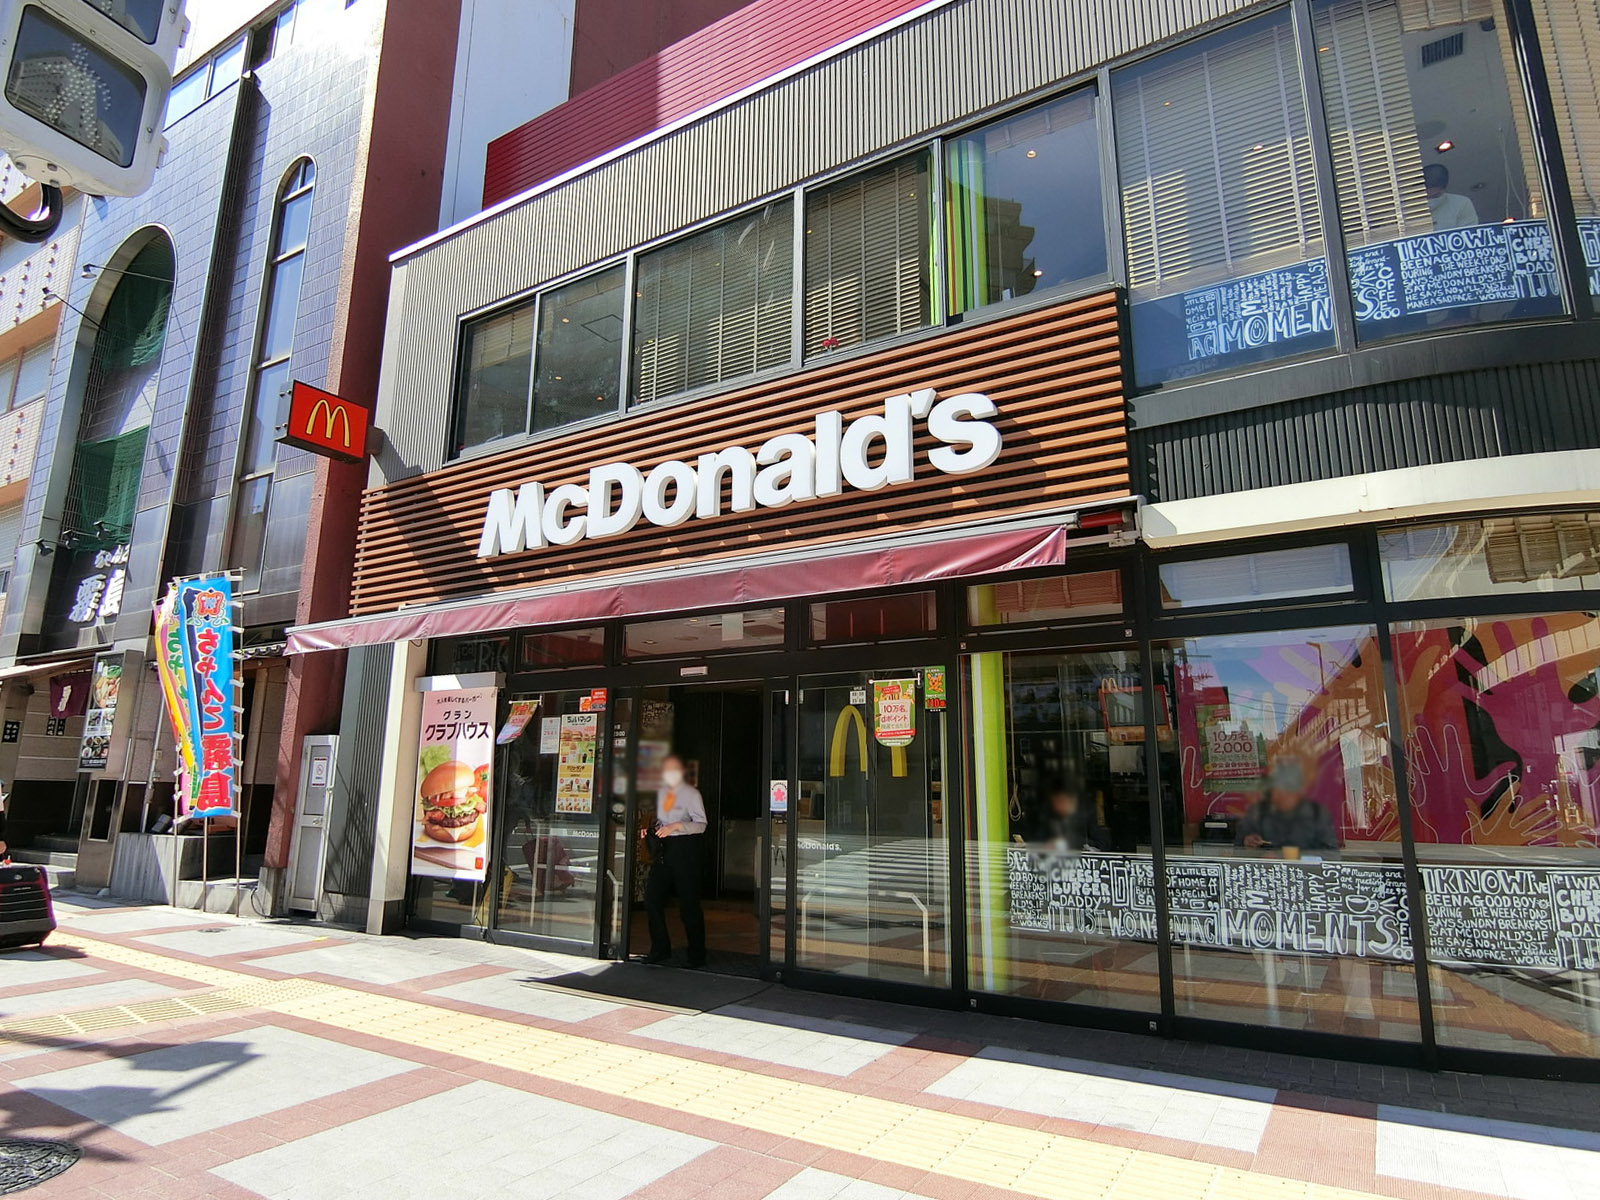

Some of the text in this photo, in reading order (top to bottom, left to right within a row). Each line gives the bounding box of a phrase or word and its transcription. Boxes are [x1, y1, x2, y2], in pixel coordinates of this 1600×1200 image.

[1524, 226, 1550, 237] WA
[1407, 229, 1487, 260] KNOW
[1512, 236, 1553, 252] CHEE
[1400, 256, 1433, 271] BEEN
[1433, 256, 1442, 265] A
[1441, 250, 1475, 264] GOOD
[1475, 248, 1496, 258] BOY
[1516, 248, 1556, 264] BUR
[1401, 265, 1434, 280] DURING
[1439, 261, 1457, 272] THE
[1456, 258, 1482, 269] WEEK
[1525, 261, 1556, 274] DAD
[1403, 262, 1510, 288] SAYS SUNDAY BREAKFAST
[1296, 272, 1313, 302] HAPPY
[1414, 284, 1426, 293] AT
[1405, 294, 1419, 303] HE
[1419, 289, 1444, 300] SAYS
[1406, 298, 1430, 310] MAKE
[1430, 298, 1437, 306] A
[1436, 295, 1453, 304] SAD
[1479, 290, 1516, 301] WORKS
[477, 388, 1005, 557] McDonald's
[443, 710, 472, 720] グラン
[425, 721, 489, 741] クラブハウス
[1213, 741, 1253, 754] 2,000
[1100, 860, 1109, 871] A
[1022, 873, 1038, 883] BOY
[1180, 877, 1206, 887] HOME
[1385, 871, 1402, 879] and
[1433, 868, 1526, 895] KNOW
[1571, 874, 1600, 890] WA
[1033, 882, 1045, 892] DAD
[1052, 882, 1111, 896] BURGER
[1308, 872, 1327, 912] HAPPY
[1011, 890, 1047, 901] BREAKFAST
[1425, 894, 1537, 909] BEEN A GOOD BOY
[1426, 905, 1463, 918] DURING
[1469, 907, 1490, 918] THE
[1490, 907, 1519, 918] WEEK
[1529, 909, 1548, 920] DAD
[1559, 906, 1600, 923] BUR
[1020, 920, 1049, 929] WORKS
[1427, 918, 1552, 931] SAYS SUNDAY BREAKFAST
[1220, 908, 1400, 957] MOMENTS
[1439, 927, 1453, 937] AT
[1537, 931, 1548, 942] IF
[1430, 938, 1444, 947] HE
[1446, 939, 1474, 948] SAYS
[1516, 941, 1547, 951] JUST
[1430, 947, 1456, 957] MAKE
[1457, 948, 1464, 957] A
[1465, 949, 1484, 959] SAD
[1514, 956, 1557, 967] WORKS
